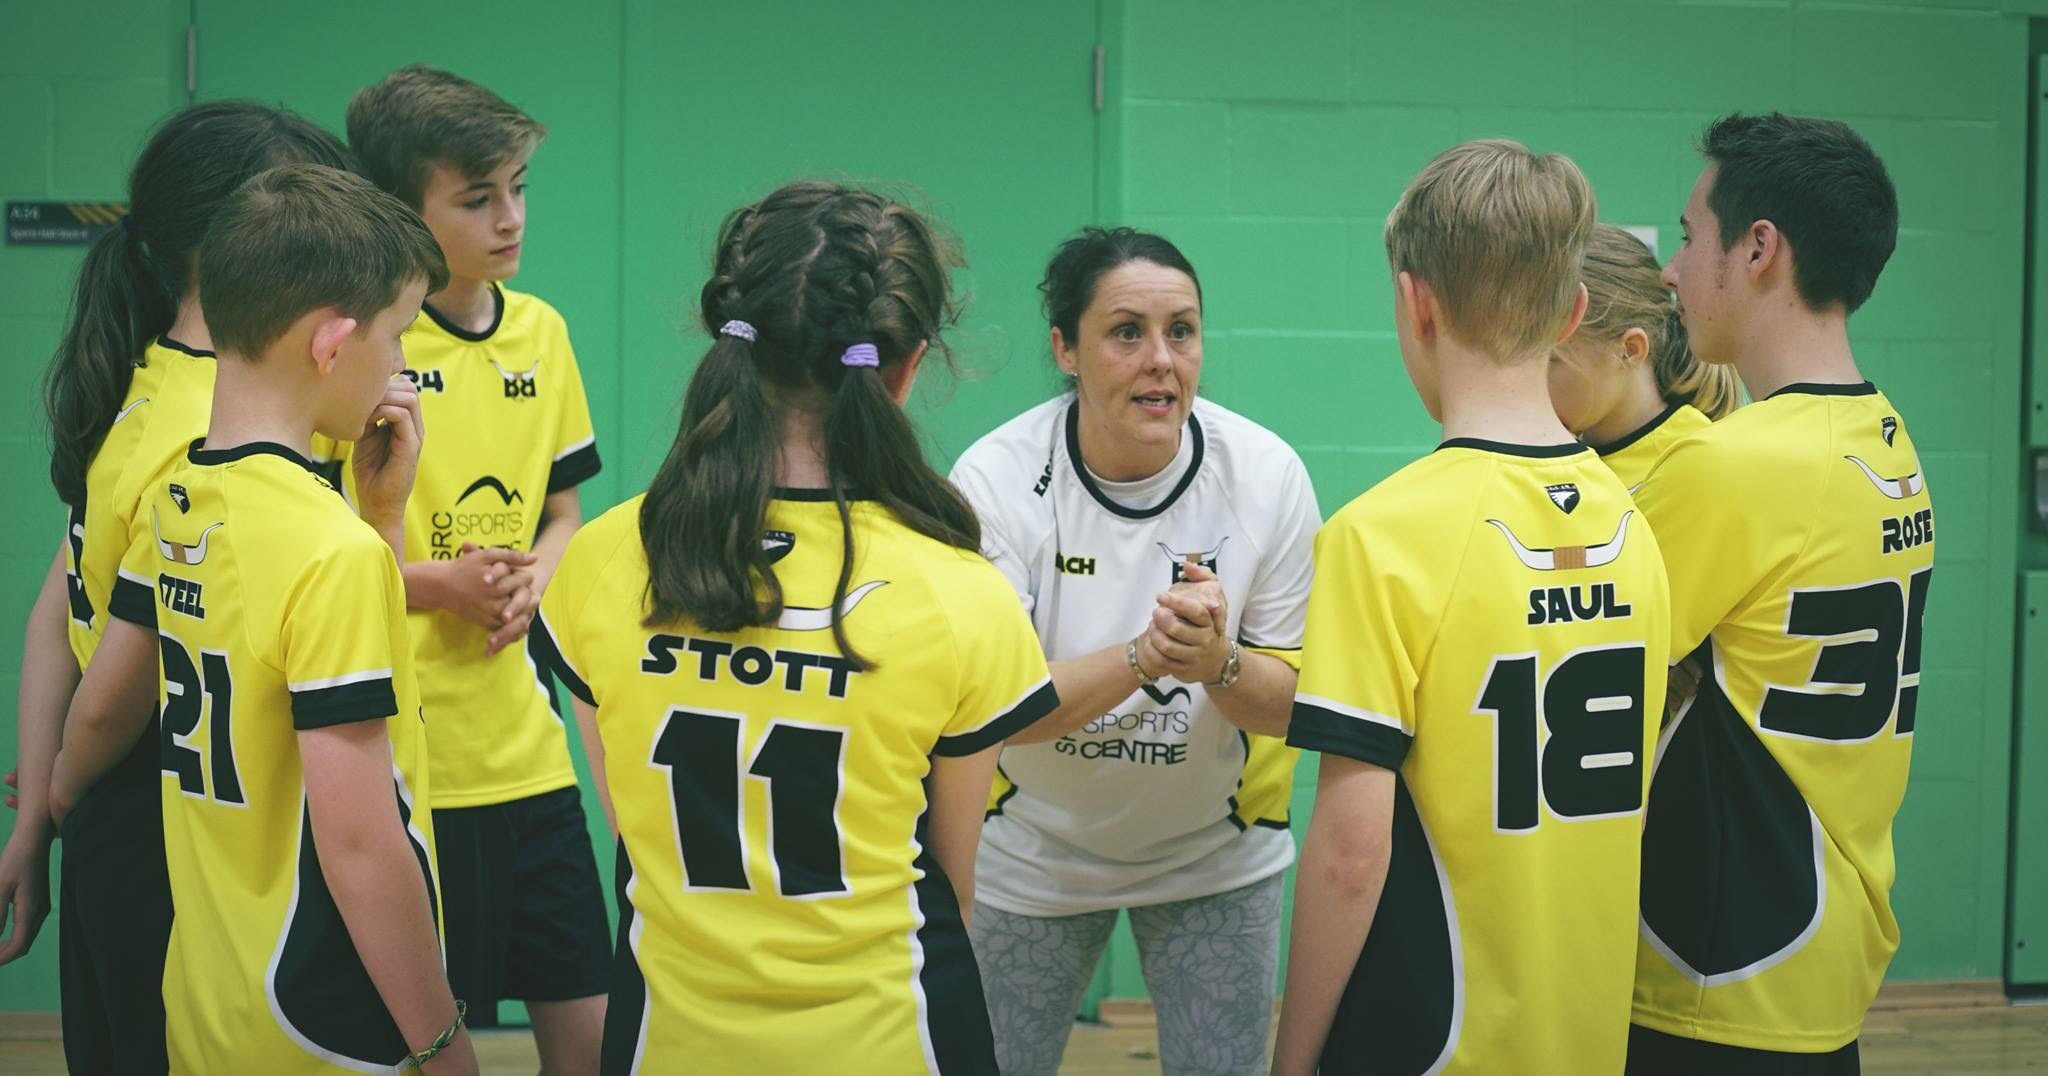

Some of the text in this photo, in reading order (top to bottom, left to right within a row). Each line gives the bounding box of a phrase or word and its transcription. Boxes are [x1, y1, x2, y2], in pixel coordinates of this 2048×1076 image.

[1881, 507, 1933, 555] ROSE
[1526, 582, 1633, 626] SAUL
[641, 633, 864, 698] STOTT
[1080, 738, 1188, 765] CENTRE
[1475, 644, 1647, 832] 18
[650, 706, 851, 898] 11
